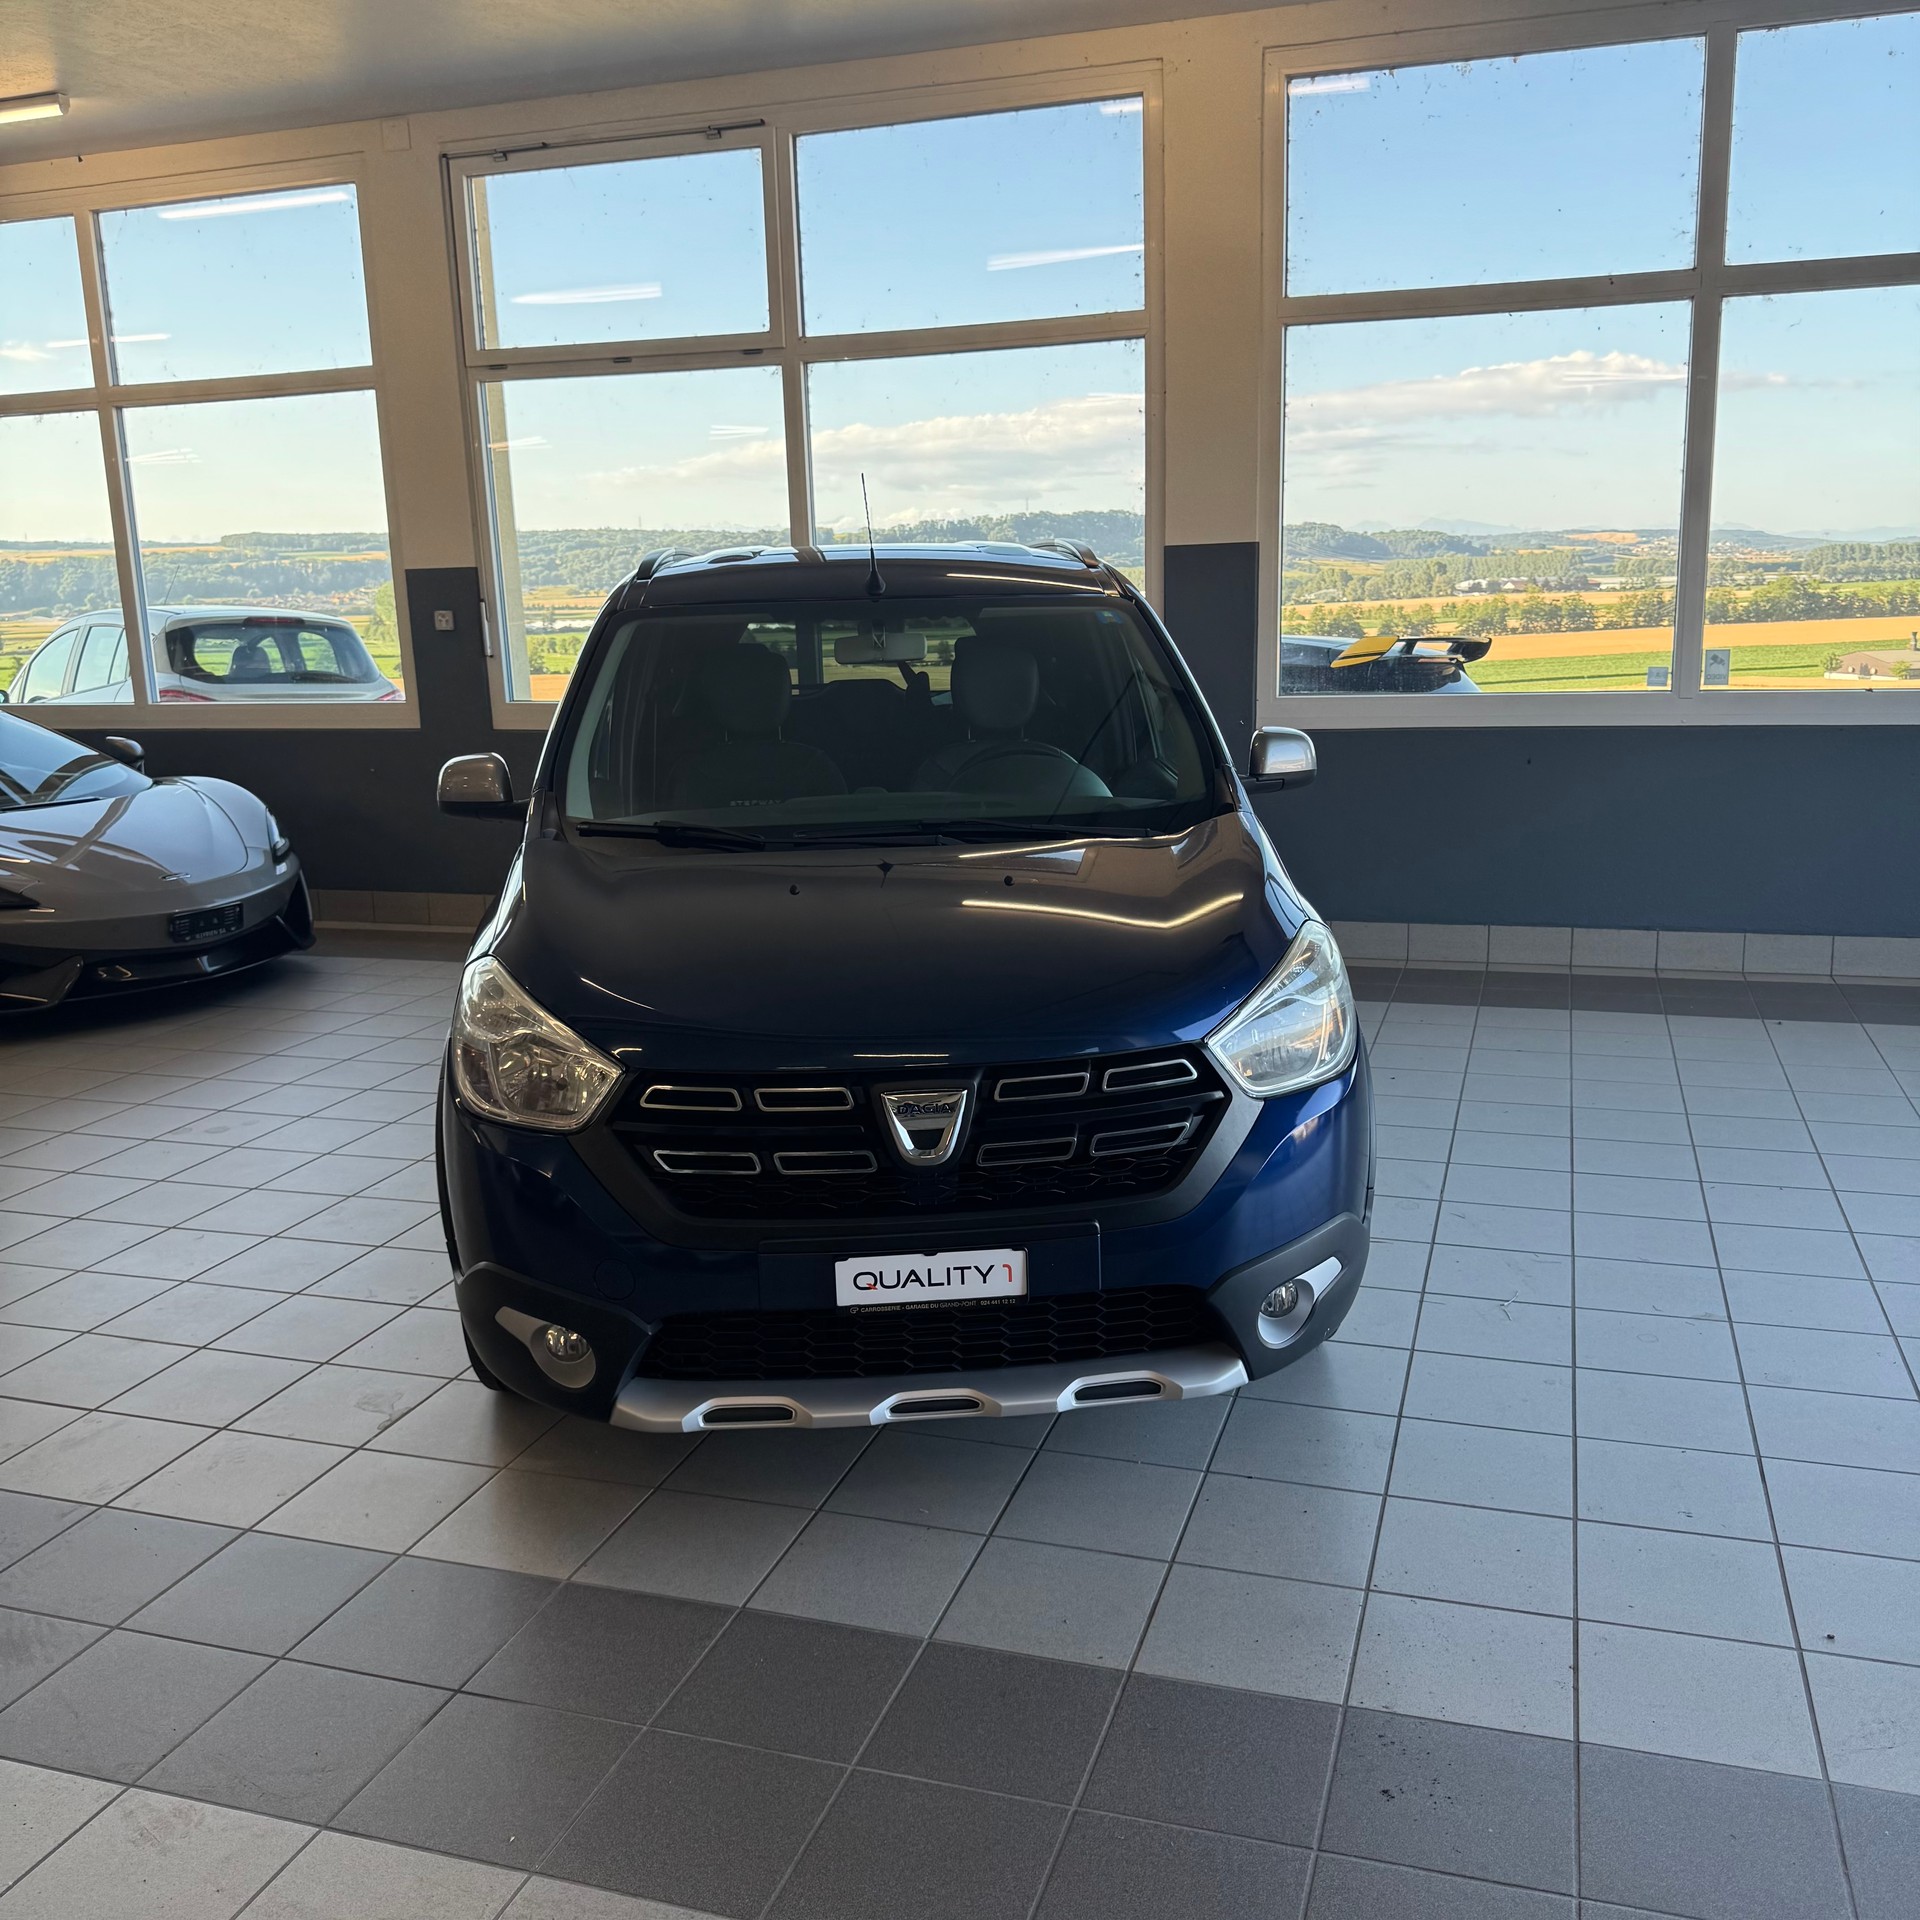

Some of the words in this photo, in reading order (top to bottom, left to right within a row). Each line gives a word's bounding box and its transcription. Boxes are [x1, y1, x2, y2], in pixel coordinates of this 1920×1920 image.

[897, 1102, 952, 1115] DACIA
[853, 1264, 995, 1291] QUALITY
[1002, 1263, 1013, 1283] 1
[939, 1300, 977, 1309] GRAND-PONT
